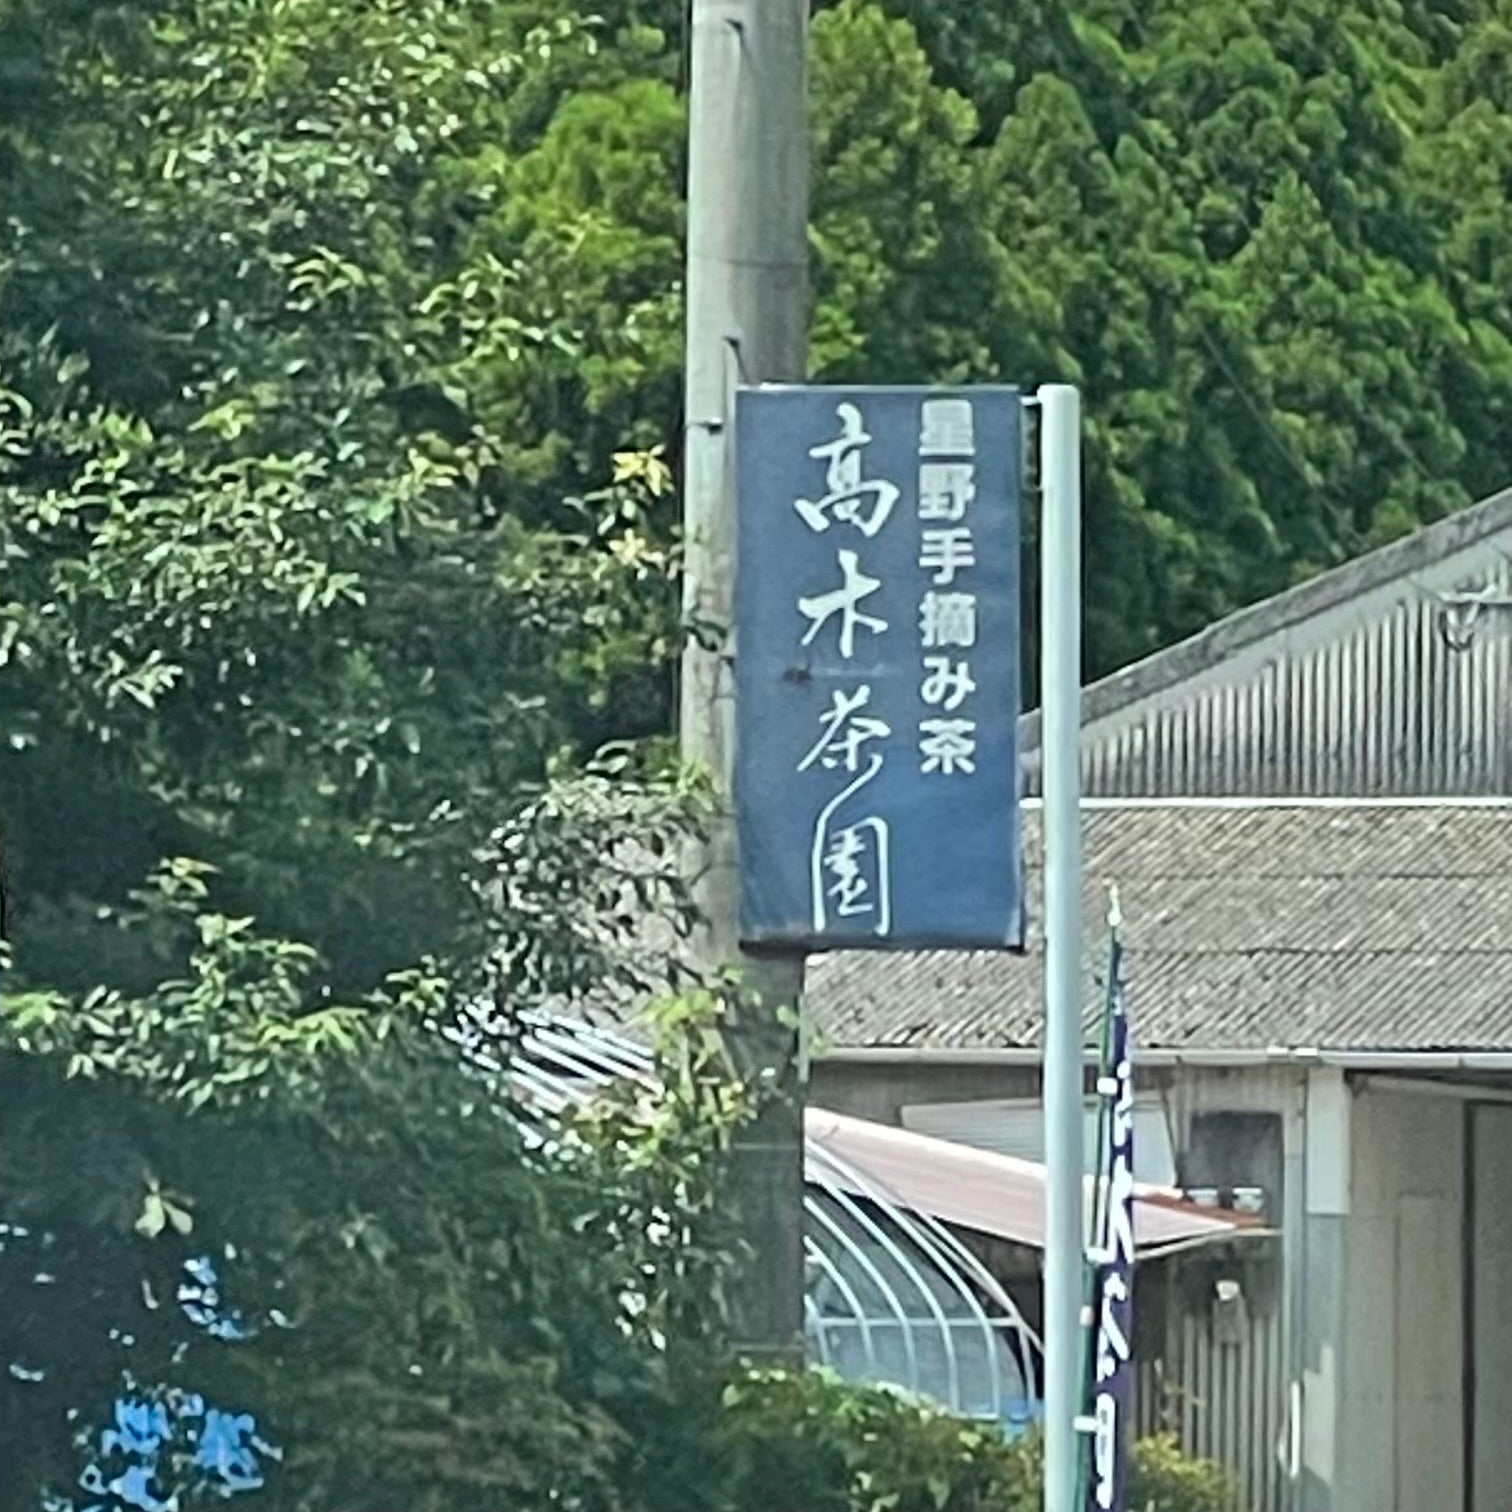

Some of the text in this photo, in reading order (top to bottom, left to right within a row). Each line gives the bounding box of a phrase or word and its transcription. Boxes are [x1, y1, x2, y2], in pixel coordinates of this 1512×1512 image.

[794, 402, 901, 936] 高木茶園
[918, 398, 977, 775] 星野手摘み茶
